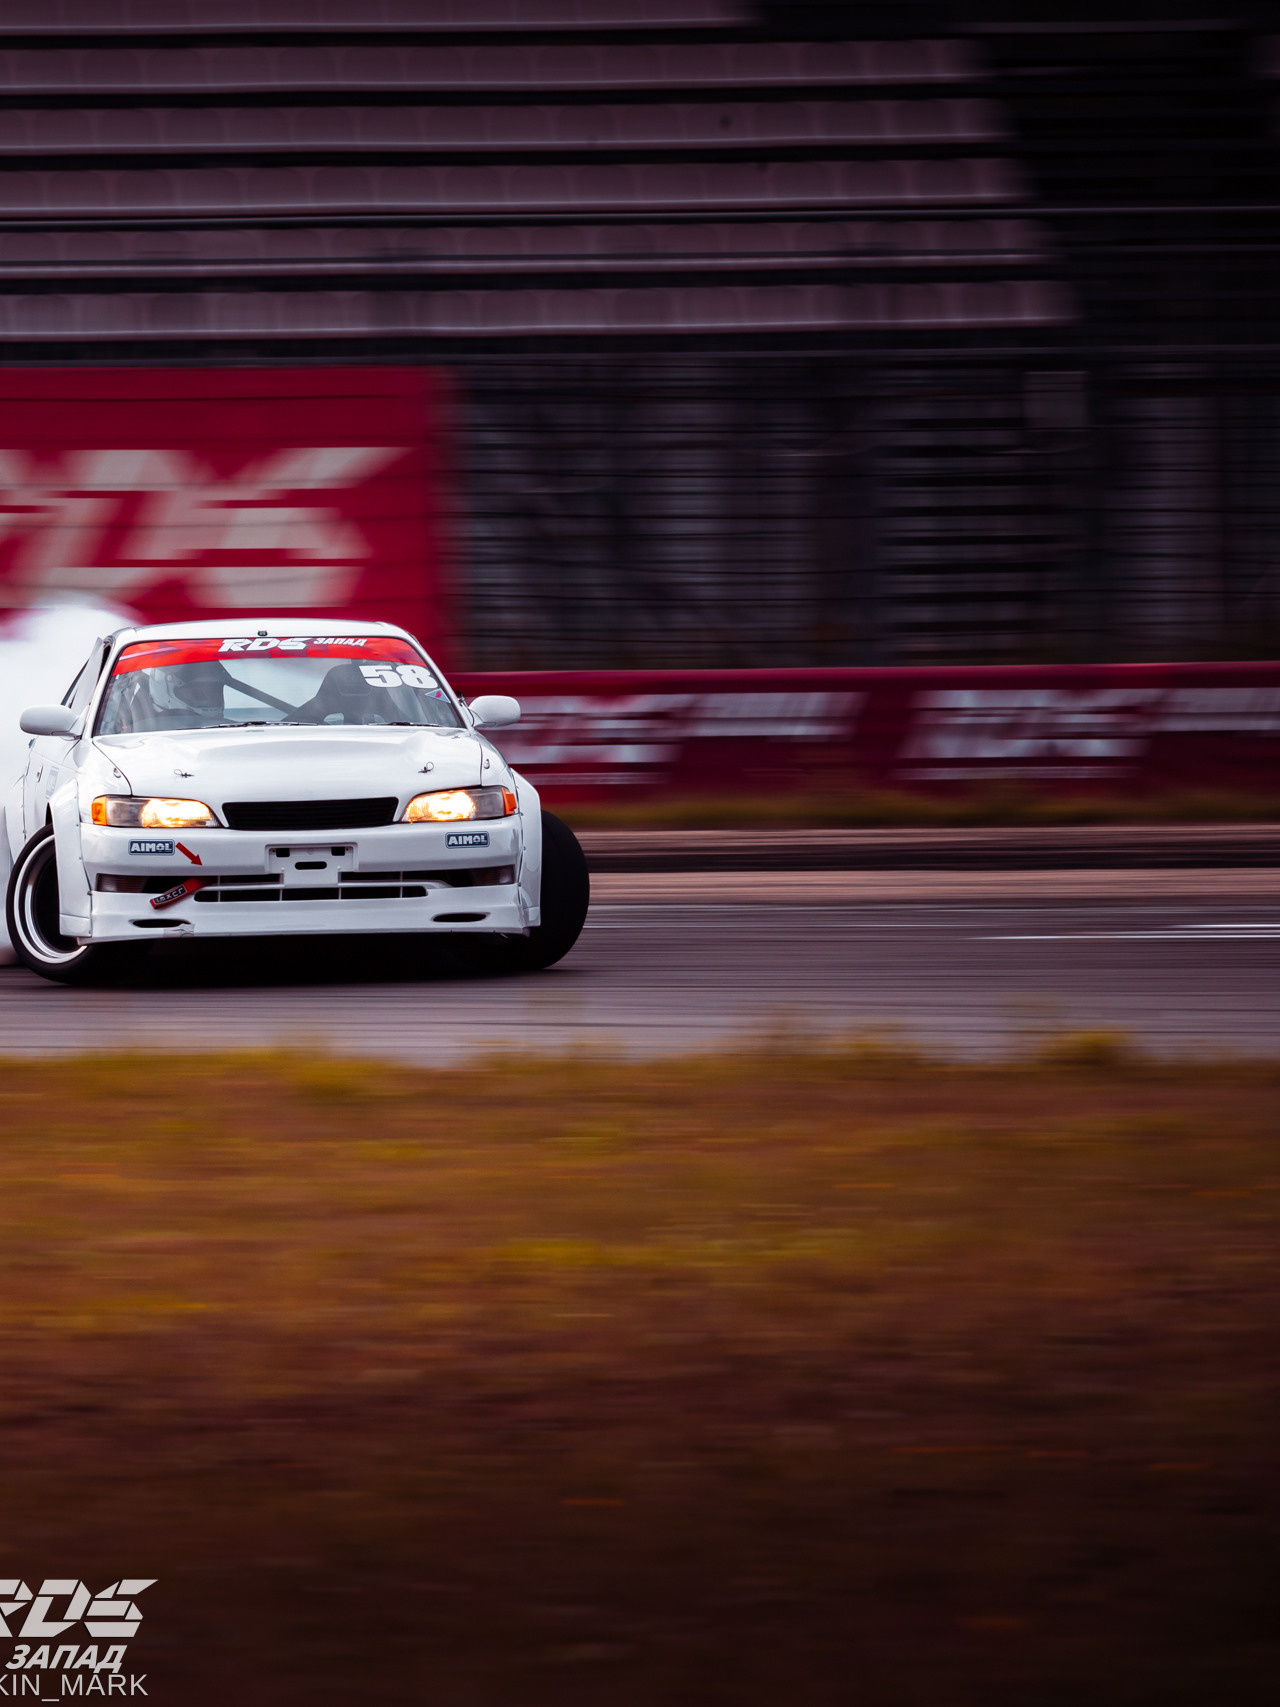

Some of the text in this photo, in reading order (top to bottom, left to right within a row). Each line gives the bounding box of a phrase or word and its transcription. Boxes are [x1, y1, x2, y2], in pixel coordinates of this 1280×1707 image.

[218, 637, 368, 653] RDS ЗАПАД
[359, 665, 439, 689] 58
[448, 835, 487, 846] AIMOL
[130, 842, 173, 853] AIMOL
